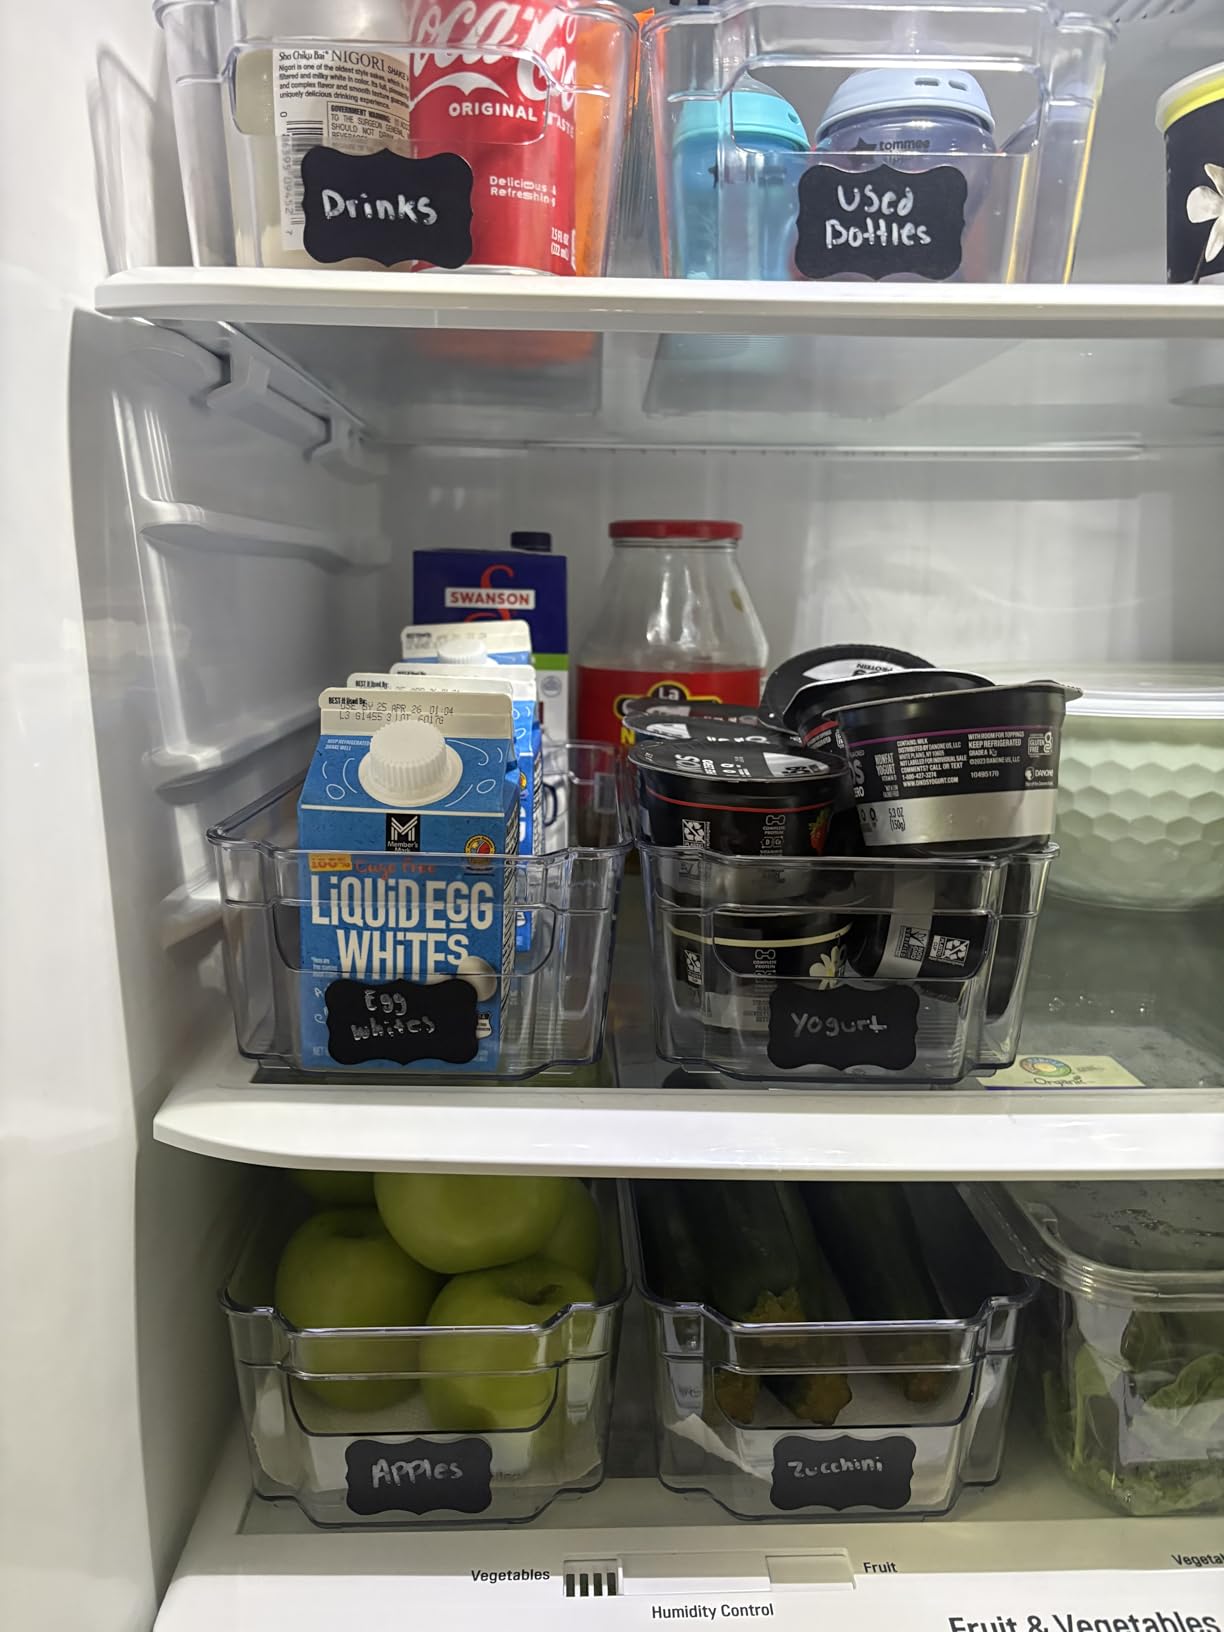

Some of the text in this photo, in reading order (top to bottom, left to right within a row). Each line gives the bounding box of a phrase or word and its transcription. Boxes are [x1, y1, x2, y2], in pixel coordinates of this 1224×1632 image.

[331, 50, 386, 72] NIGORI
[331, 114, 340, 122] TO
[344, 115, 354, 124] THE
[449, 103, 538, 124] ORIGINAL
[331, 122, 358, 132] SHOULD
[362, 128, 374, 136] NOT
[879, 138, 930, 152] tommee
[322, 188, 438, 226] Drinks
[825, 217, 932, 249] Bottles
[450, 592, 530, 606] SWANSON
[658, 686, 680, 700] La
[339, 711, 351, 720] L3
[376, 702, 388, 712] 25
[392, 704, 406, 713] APR
[411, 705, 422, 714] 26
[430, 706, 454, 717] 01:04
[968, 738, 1022, 749] KEEP REFRIGERATED
[929, 764, 942, 772] CALL
[888, 807, 904, 818] 5.3 OZ
[890, 817, 906, 832] (150g)
[388, 840, 418, 848] Member's
[426, 880, 495, 931] EGG
[364, 989, 407, 1016] Egg
[790, 1012, 888, 1038] Yogurt
[863, 1561, 899, 1574] Fruit
[471, 1568, 551, 1582] Vegetables
[652, 1602, 774, 1622] Humidity Control
[948, 1616, 1018, 1632] Fruit
[1052, 1612, 1220, 1632] Vegetables
